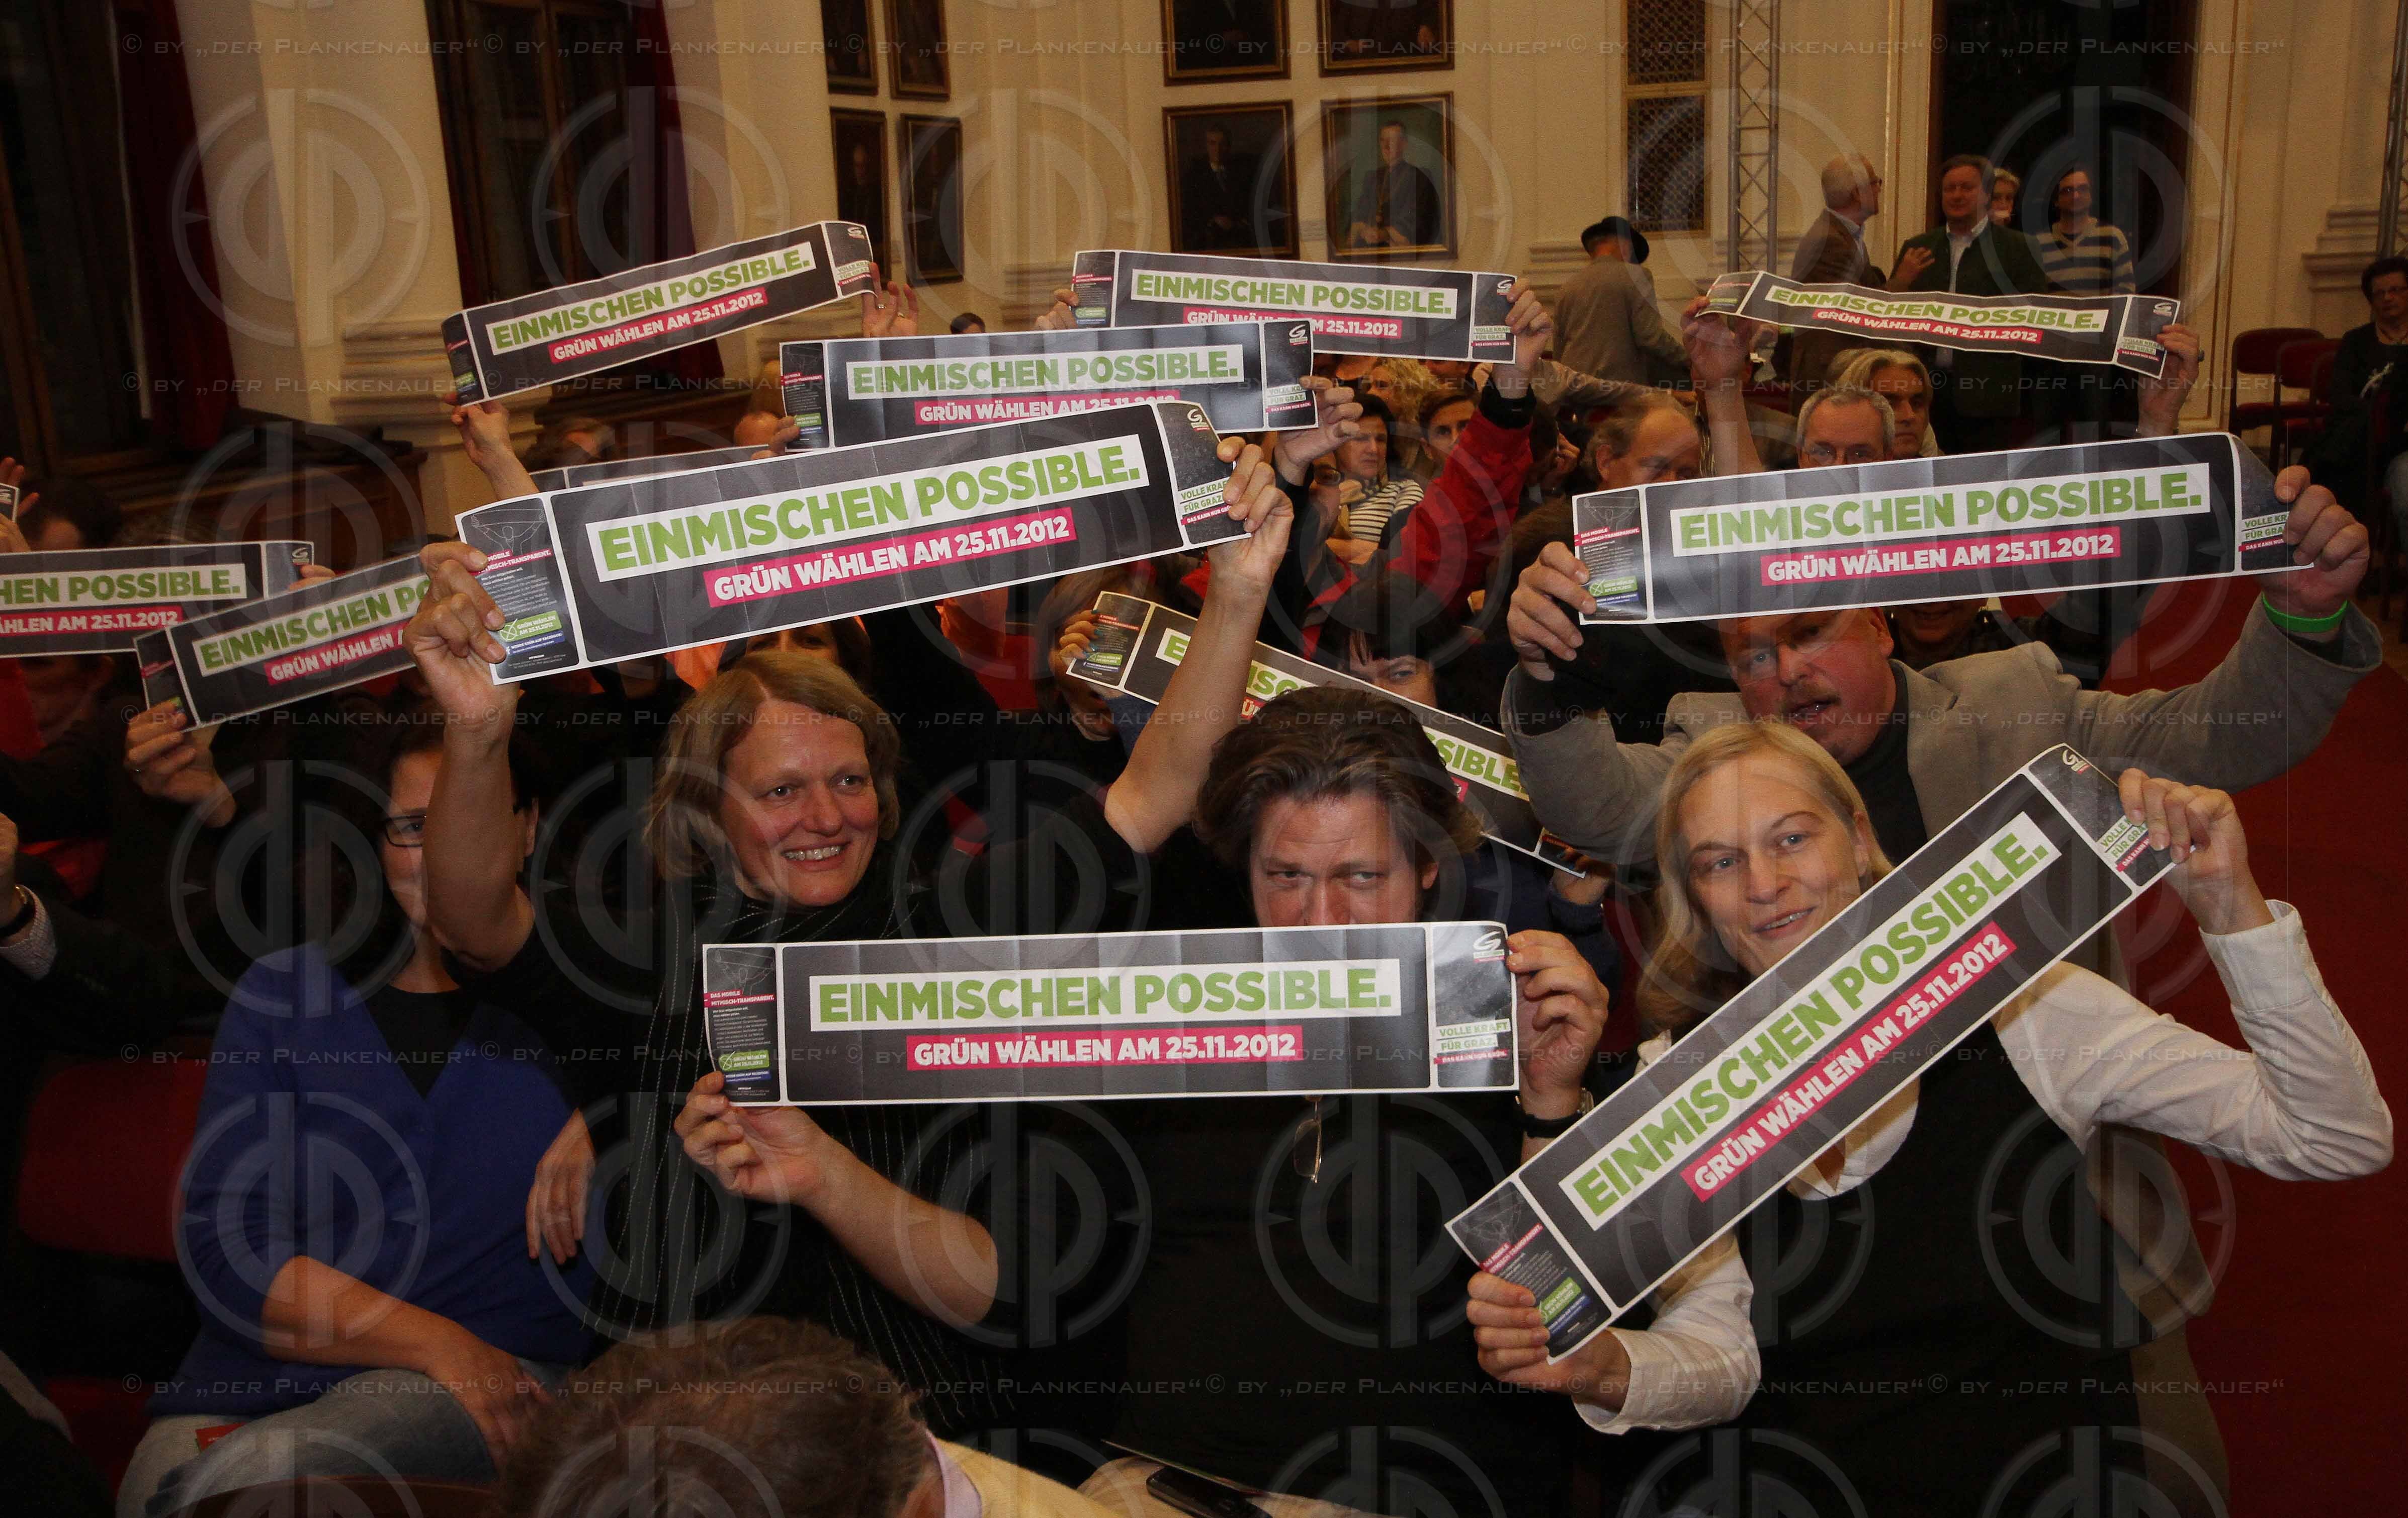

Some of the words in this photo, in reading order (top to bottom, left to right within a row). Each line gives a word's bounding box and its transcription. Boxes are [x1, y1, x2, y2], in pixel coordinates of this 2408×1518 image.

[492, 287, 665, 349] EINMISCHEN
[670, 250, 811, 303] POSSIBLE.
[1136, 274, 1300, 306] EINMISCHEN
[1313, 285, 1451, 314] POSSIBLE.
[1772, 289, 1944, 317] EINMISCHEN
[1949, 308, 2100, 328] POSSIBLE.
[555, 339, 596, 359] GRÜN
[598, 320, 664, 347] WÄHLEN
[667, 313, 692, 330] AM
[693, 293, 763, 322] 25.11.2012
[1326, 320, 1398, 336] 25.11.2012
[1819, 312, 1860, 323] GRÜN
[1865, 319, 1930, 330] WÄHLEN
[1934, 326, 1957, 334] AM
[1961, 330, 2037, 341] 25.11.2012
[853, 357, 1058, 394] EINMISCHEN
[1067, 351, 1239, 385] POSSIBLE.
[920, 402, 971, 421] GRÜN
[975, 400, 1055, 419] WÄHLEN
[1057, 399, 1086, 413] AM
[598, 481, 909, 571] EINMISCHEN
[914, 445, 1140, 516] POSSIBLE.
[1181, 486, 1206, 500] VOLLE
[1207, 479, 1228, 494] KRAF
[1184, 501, 1199, 513] FÜR
[1186, 516, 1197, 524] DAS
[1197, 512, 1211, 521] KANN
[1681, 493, 1955, 548] EINMISCHEN
[1967, 472, 2201, 525] POSSIBLE.
[2245, 516, 2273, 528] VOLLE
[2245, 530, 2263, 540] FÜR
[714, 565, 792, 600] GRÜN
[794, 545, 908, 585] WÄHLEN
[914, 537, 952, 564] AM
[955, 516, 1069, 556] 25.11.2012
[1768, 554, 1837, 581] GRÜN
[1845, 549, 1947, 575] WÄHLEN
[1952, 545, 1990, 566] AM
[1996, 535, 2113, 562] 25.11.2012
[69, 570, 240, 601] POSSIBLE.
[58, 615, 87, 631] AM
[92, 611, 180, 629] 25.11.2012
[200, 593, 393, 669] EINMISCHEN
[272, 655, 319, 680] GRÜN
[321, 634, 394, 665] WÄHLEN
[819, 975, 1121, 1023] EINMISCHEN
[1135, 968, 1392, 1015] POSSIBLE.
[1440, 1026, 1473, 1037] VOLLE
[1474, 1022, 1508, 1033] KRAFT
[1573, 991, 1841, 1217] EINMISCHEN
[1829, 831, 2047, 1010] POSSIBLE.
[915, 1038, 989, 1065] GRÜN
[995, 1036, 1111, 1063] WÄHLEN
[1117, 1037, 1160, 1060] AM
[1166, 1034, 1296, 1059] 25.11.2012
[1441, 1039, 1462, 1051] FÜR
[1695, 1128, 1770, 1190] GRÜN
[1758, 1049, 1862, 1148] WÄHLEN
[1861, 1018, 1903, 1060] AM
[1896, 934, 2007, 1029] 25.11.2012
